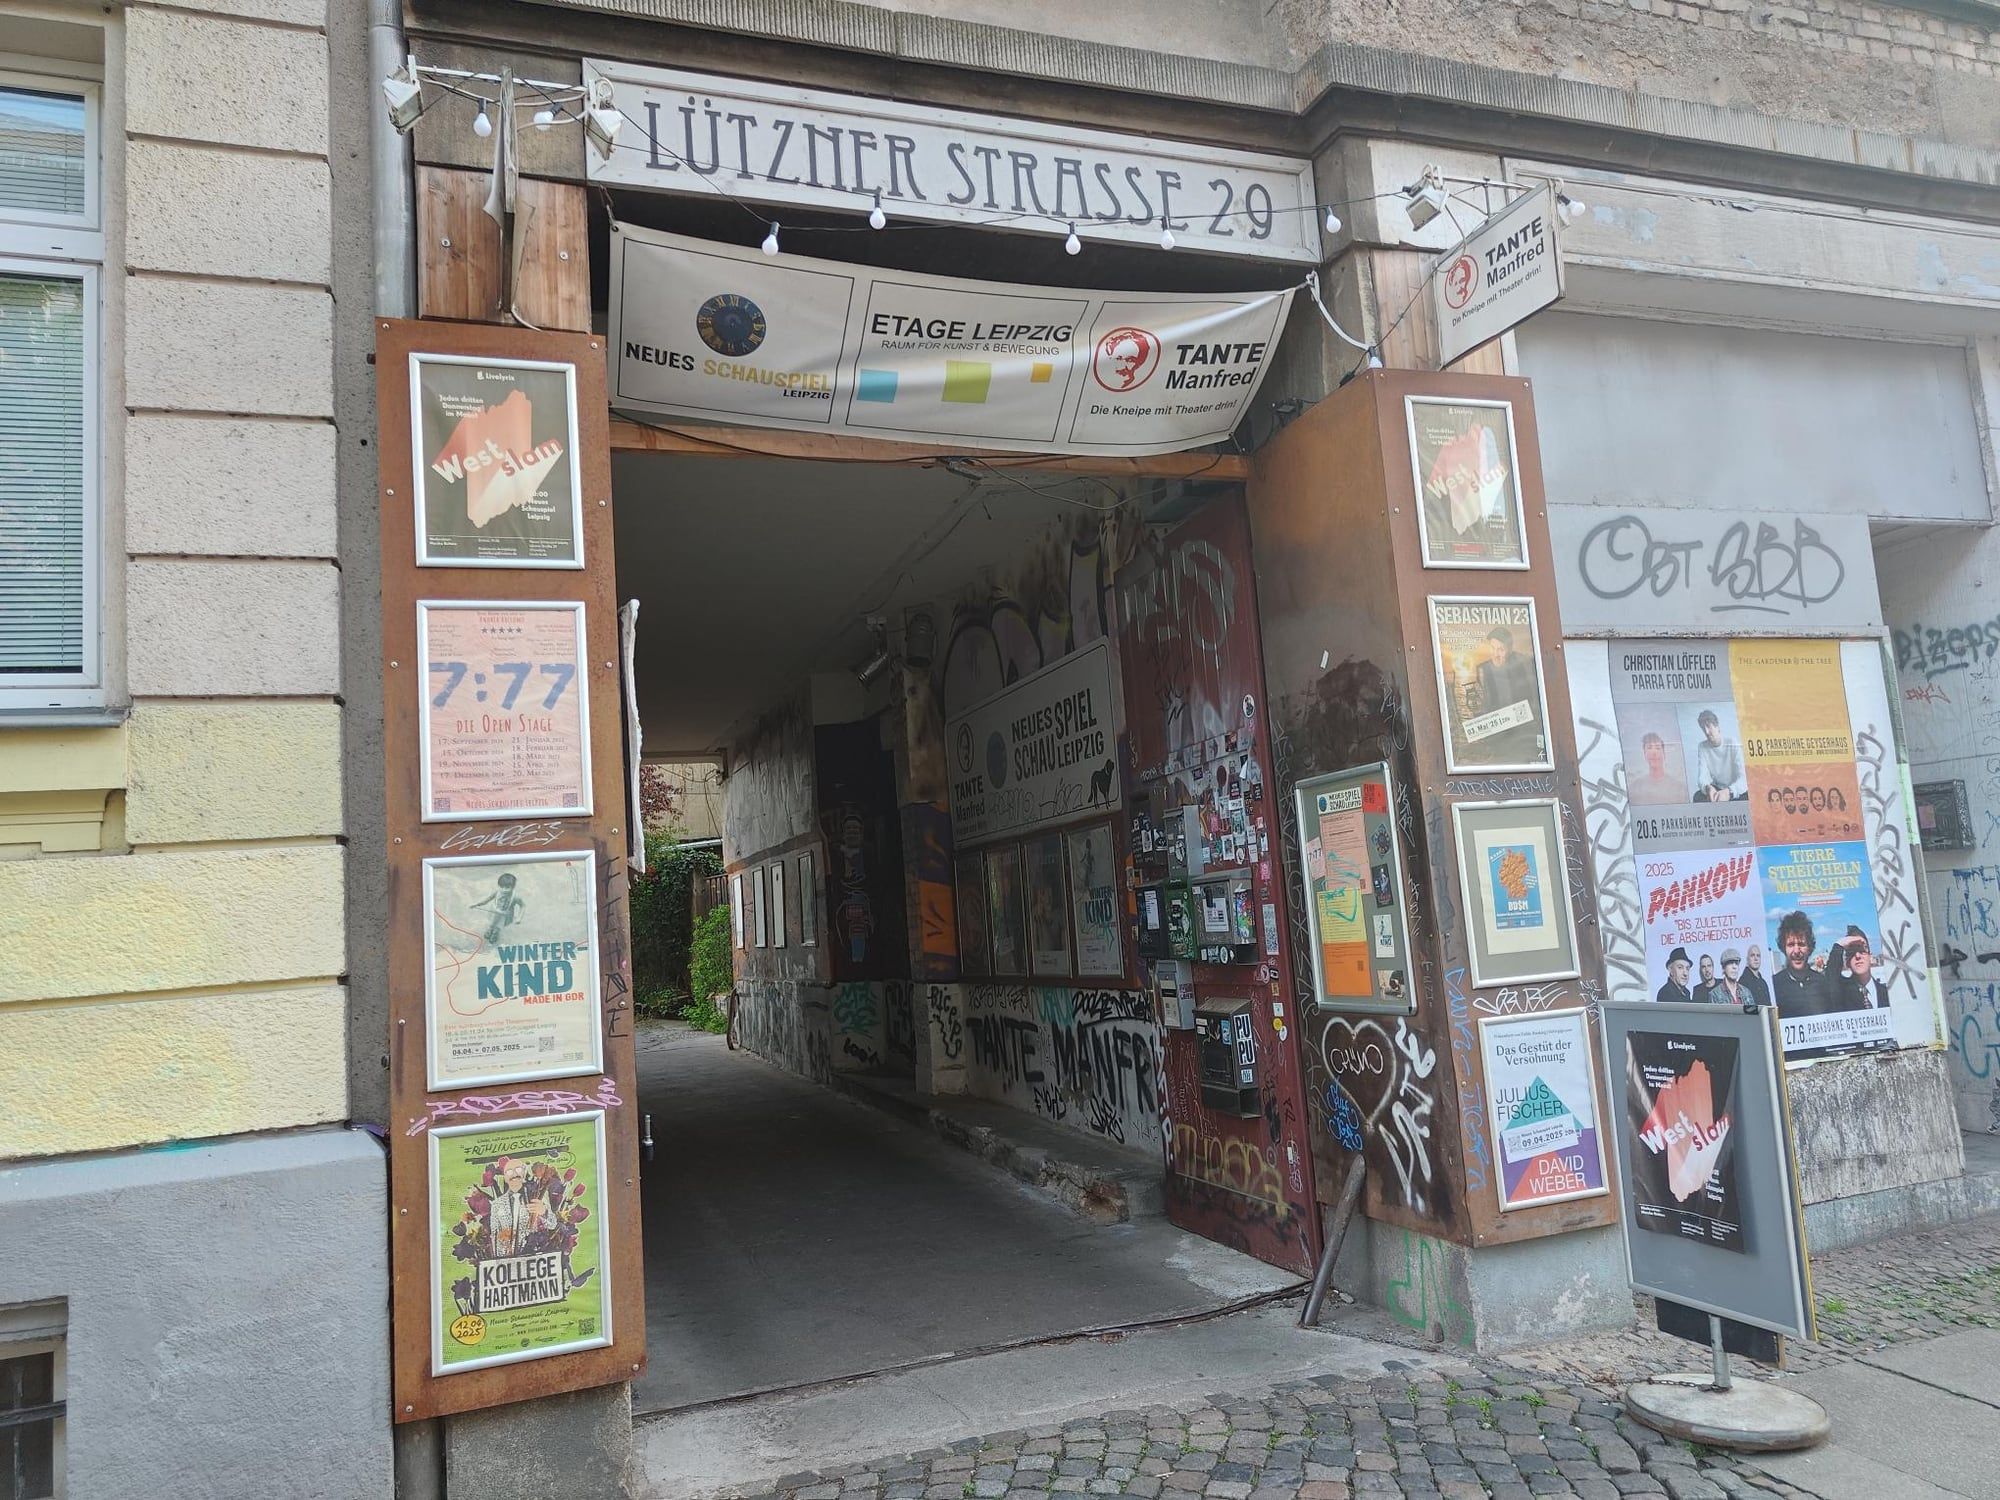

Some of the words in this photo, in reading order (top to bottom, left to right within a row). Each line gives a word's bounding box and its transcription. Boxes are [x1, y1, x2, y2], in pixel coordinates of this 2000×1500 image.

[643, 94, 926, 201] LÜTZNER
[946, 141, 1189, 231] STRASSE
[1207, 178, 1273, 240] 29
[1484, 216, 1543, 267] TANTE
[1485, 237, 1545, 289] Manfred
[1462, 302, 1485, 320] Kneipe
[1486, 294, 1498, 306] mit
[1498, 278, 1524, 300] Theater
[1524, 265, 1542, 281] drin!
[870, 313, 966, 341] ETAGE
[971, 322, 1074, 343] LEIPZIG
[881, 339, 915, 351] RAUM
[917, 339, 941, 351] FÜR
[943, 341, 982, 352] KUNST
[982, 342, 992, 353] &
[992, 342, 1060, 356] BEWEGUNG
[1176, 342, 1266, 366] TANTE
[625, 341, 695, 371] NEUES
[703, 359, 833, 392] SCHAUSPIEL
[1164, 367, 1257, 391] Manfred
[782, 388, 830, 400] LEIPZIG
[1090, 404, 1111, 416] Die
[1112, 404, 1152, 418] Kneipe
[1154, 404, 1172, 416] mit
[1173, 403, 1214, 416] Theater
[1214, 399, 1238, 412] drin!
[432, 437, 505, 485] West
[1426, 463, 1473, 500] West
[1436, 606, 1511, 625] SEBASTIAN
[1512, 607, 1529, 625] 23
[1623, 655, 1675, 672] CHRISTIAN
[1676, 654, 1717, 671] LÖFFLER
[428, 661, 576, 711] 7:77
[1632, 673, 1665, 690] PARRA
[1666, 673, 1686, 690] FOR
[1687, 673, 1712, 689] CUVA
[1011, 706, 1053, 743] NEUES
[1054, 687, 1097, 739] SPIEL
[1013, 733, 1056, 782] SCHAU
[1056, 730, 1105, 768] LEIPZIG
[1747, 739, 1767, 757] 9.8.
[1765, 736, 1805, 750] PARKBÜHNE
[1806, 736, 1848, 749] GEYSERHAUS
[954, 775, 984, 801] TANTE
[1344, 788, 1361, 802] SPIEL
[1636, 819, 1661, 839] 20.6.
[1661, 815, 1702, 831] PARKBÜHNE
[1703, 814, 1748, 828] GEYSERHAUS
[1790, 847, 1836, 864] TIERE
[1644, 863, 1675, 878] 2025
[1768, 861, 1861, 880] STREICHELN
[1646, 851, 1753, 926] PANKOW
[1775, 875, 1860, 894] MENSCHEN
[1084, 898, 1113, 924] KIND
[1660, 932, 1677, 946] DIE
[1678, 926, 1752, 944] ABSCHIEDSTOUR
[497, 941, 589, 964] WINTER-
[476, 961, 574, 1000] KIND
[523, 993, 551, 1006] MADE
[552, 993, 563, 1003] IN
[565, 992, 585, 1002] GDR
[1784, 1024, 1808, 1045] 27.6.
[1807, 1018, 1844, 1034] PARKBÜHNE
[1845, 1014, 1888, 1030] GEYSERHAUS
[966, 1013, 1045, 1083] TANTE
[1496, 1044, 1516, 1057] Das
[1518, 1040, 1553, 1054] Gestüt
[1555, 1039, 1572, 1051] der
[1496, 1084, 1550, 1105] JULIUS
[1497, 1099, 1563, 1121] FISCHER
[1522, 1130, 1563, 1148] 09.04.2025
[1639, 1110, 1695, 1155] West
[1538, 1154, 1584, 1176] DAVID
[1529, 1172, 1586, 1195] WEBER
[483, 1256, 558, 1287] KOLLEGE
[483, 1278, 560, 1309] HARTMANN
[457, 1327, 481, 1339] 2025
